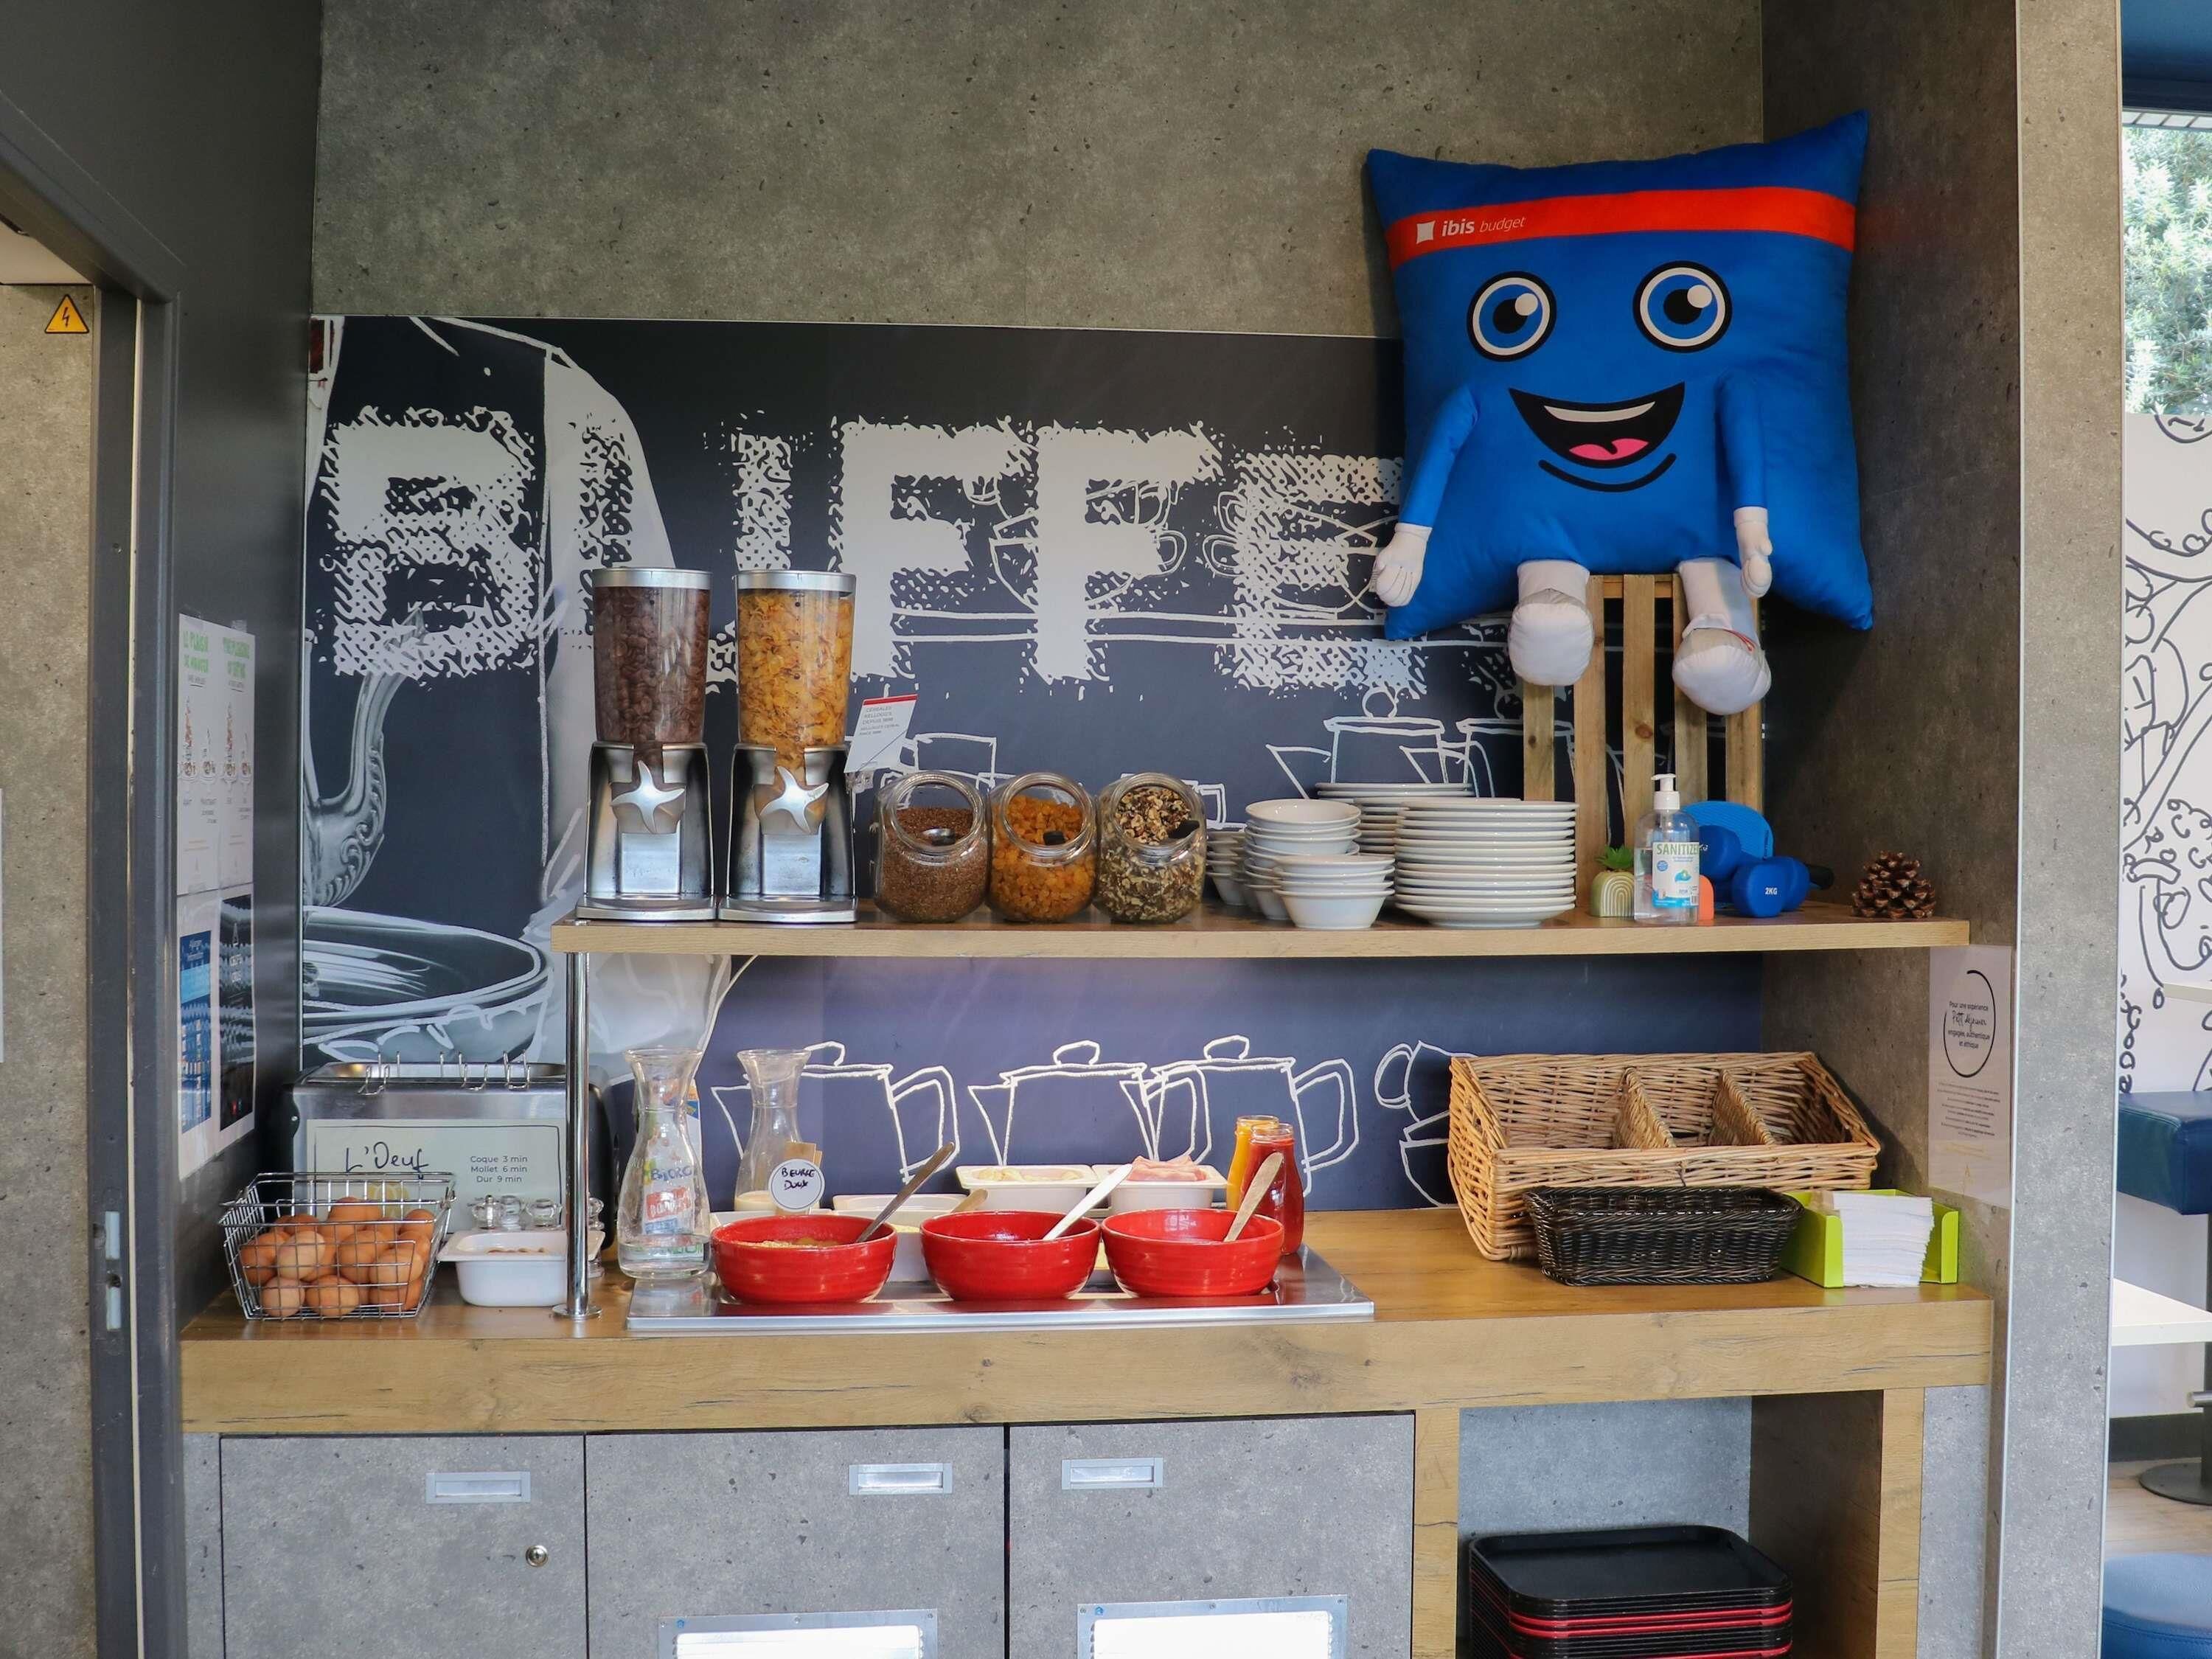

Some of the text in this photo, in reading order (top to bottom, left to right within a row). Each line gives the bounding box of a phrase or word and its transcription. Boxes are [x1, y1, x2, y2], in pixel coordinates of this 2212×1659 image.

[1441, 216, 1526, 237] ibis budget
[319, 403, 1464, 697] BUFFE
[1764, 887, 1778, 895] 2KG
[470, 1155, 499, 1164] Coque
